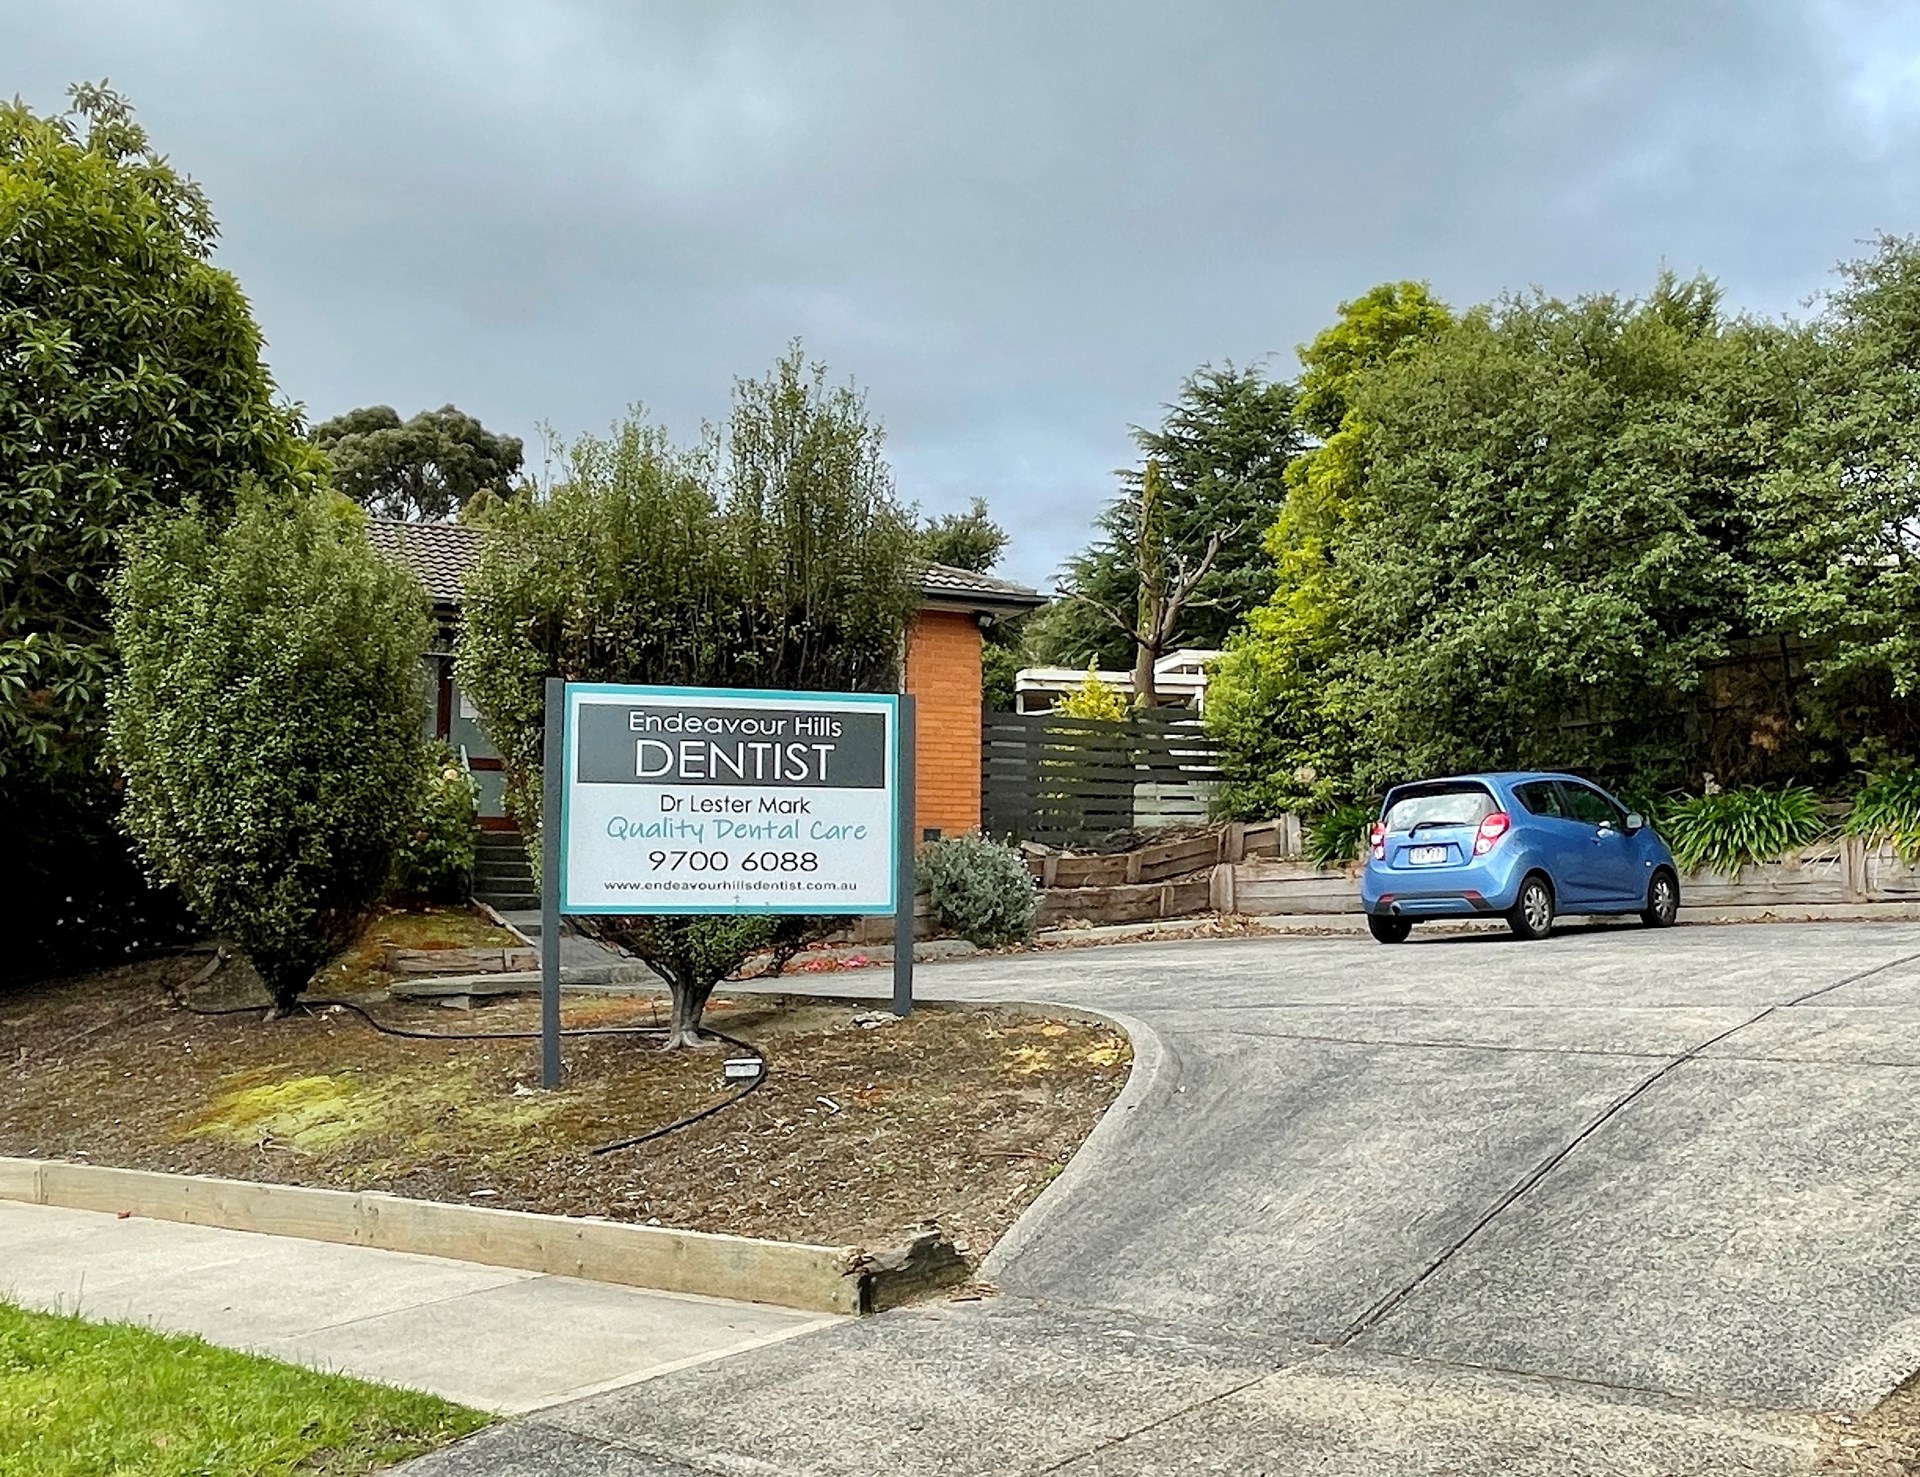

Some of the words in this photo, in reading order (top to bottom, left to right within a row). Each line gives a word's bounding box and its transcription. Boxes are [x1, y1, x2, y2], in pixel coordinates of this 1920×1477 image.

[628, 711, 788, 735] Endeavour
[794, 716, 843, 738] Hills
[634, 738, 836, 781] DENTIST
[660, 795, 683, 813] Dr
[690, 795, 753, 814] Lester
[758, 797, 811, 815] Mark
[606, 816, 705, 844] Quality
[712, 818, 800, 840] Dental
[809, 819, 868, 841] Care
[648, 850, 729, 872] 9700
[741, 851, 819, 872] 6088
[603, 880, 858, 892] www.endeavourhillsdentist.com.au
